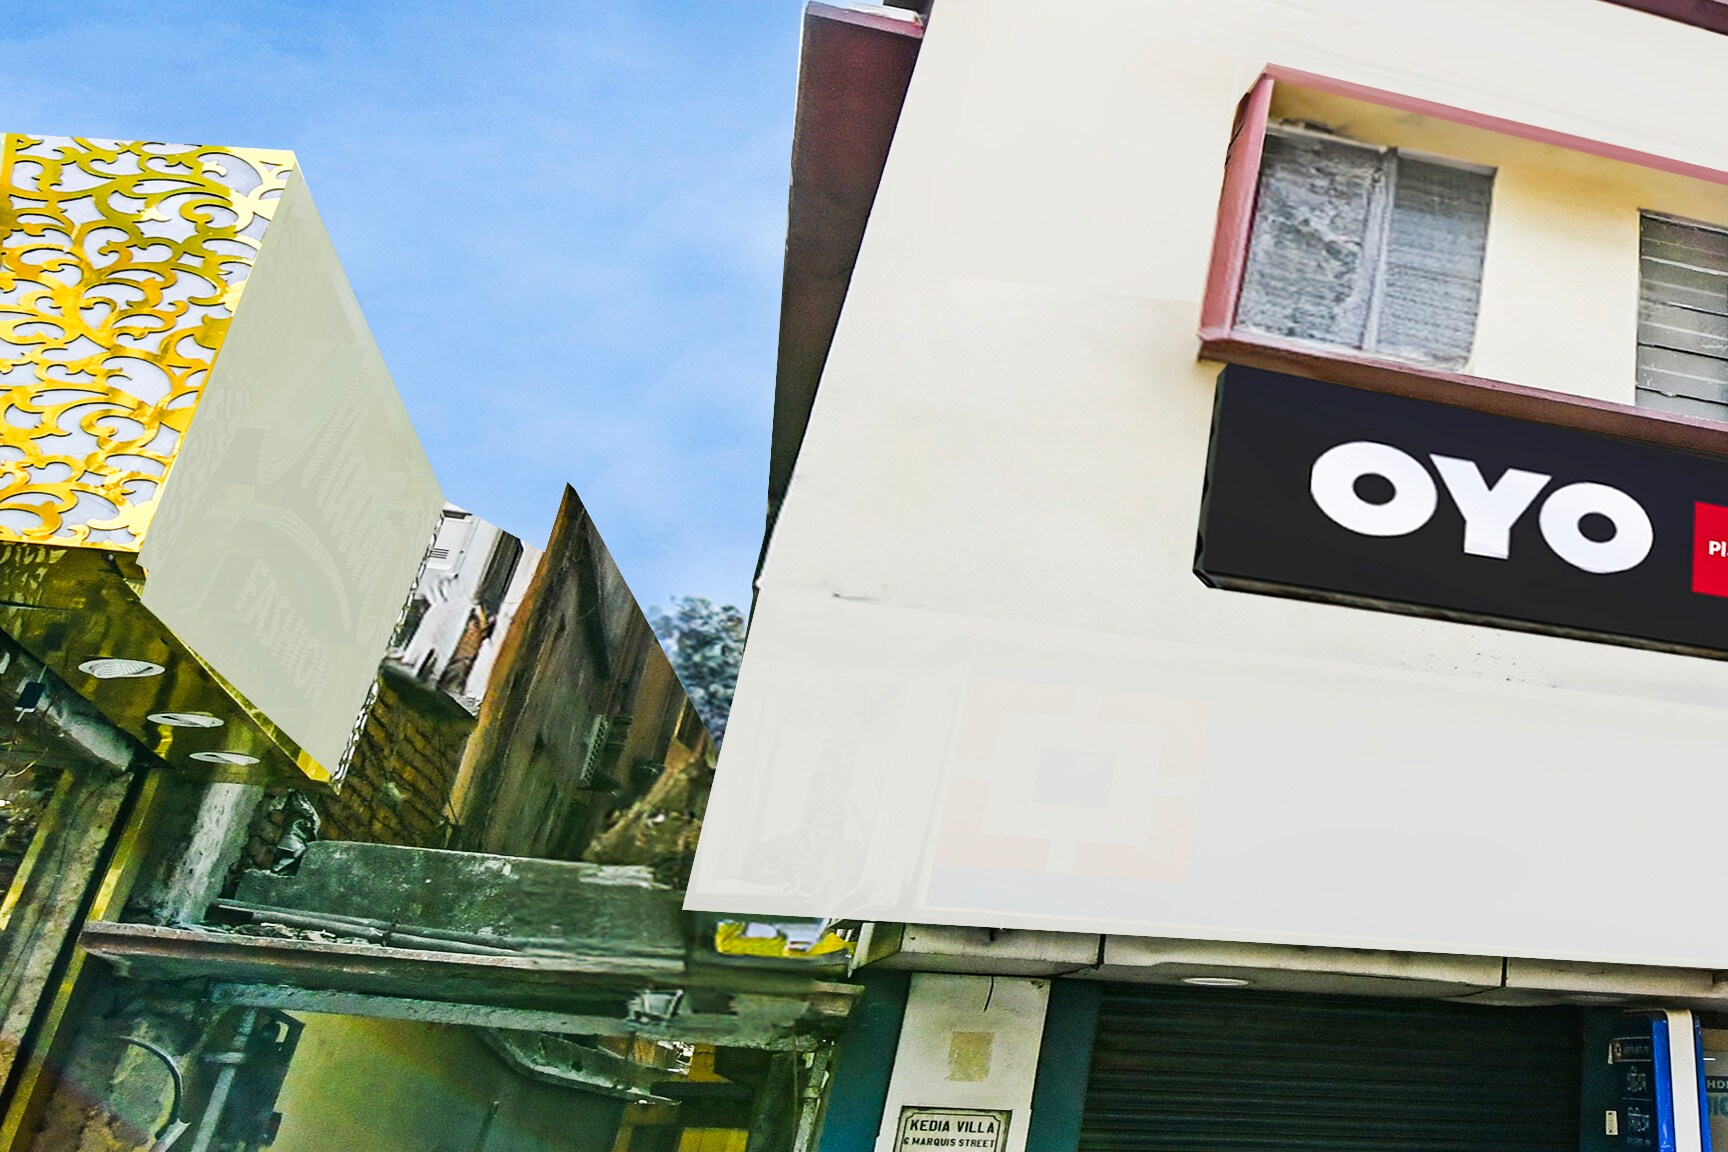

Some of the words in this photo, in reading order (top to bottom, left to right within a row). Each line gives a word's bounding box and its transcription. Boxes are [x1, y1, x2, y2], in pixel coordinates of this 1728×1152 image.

[1311, 441, 1654, 574] OYO
[910, 1119, 950, 1133] KEDIA
[957, 1121, 995, 1134] VILLA
[912, 1137, 956, 1147] MARQUIS
[958, 1139, 996, 1148] STREET
